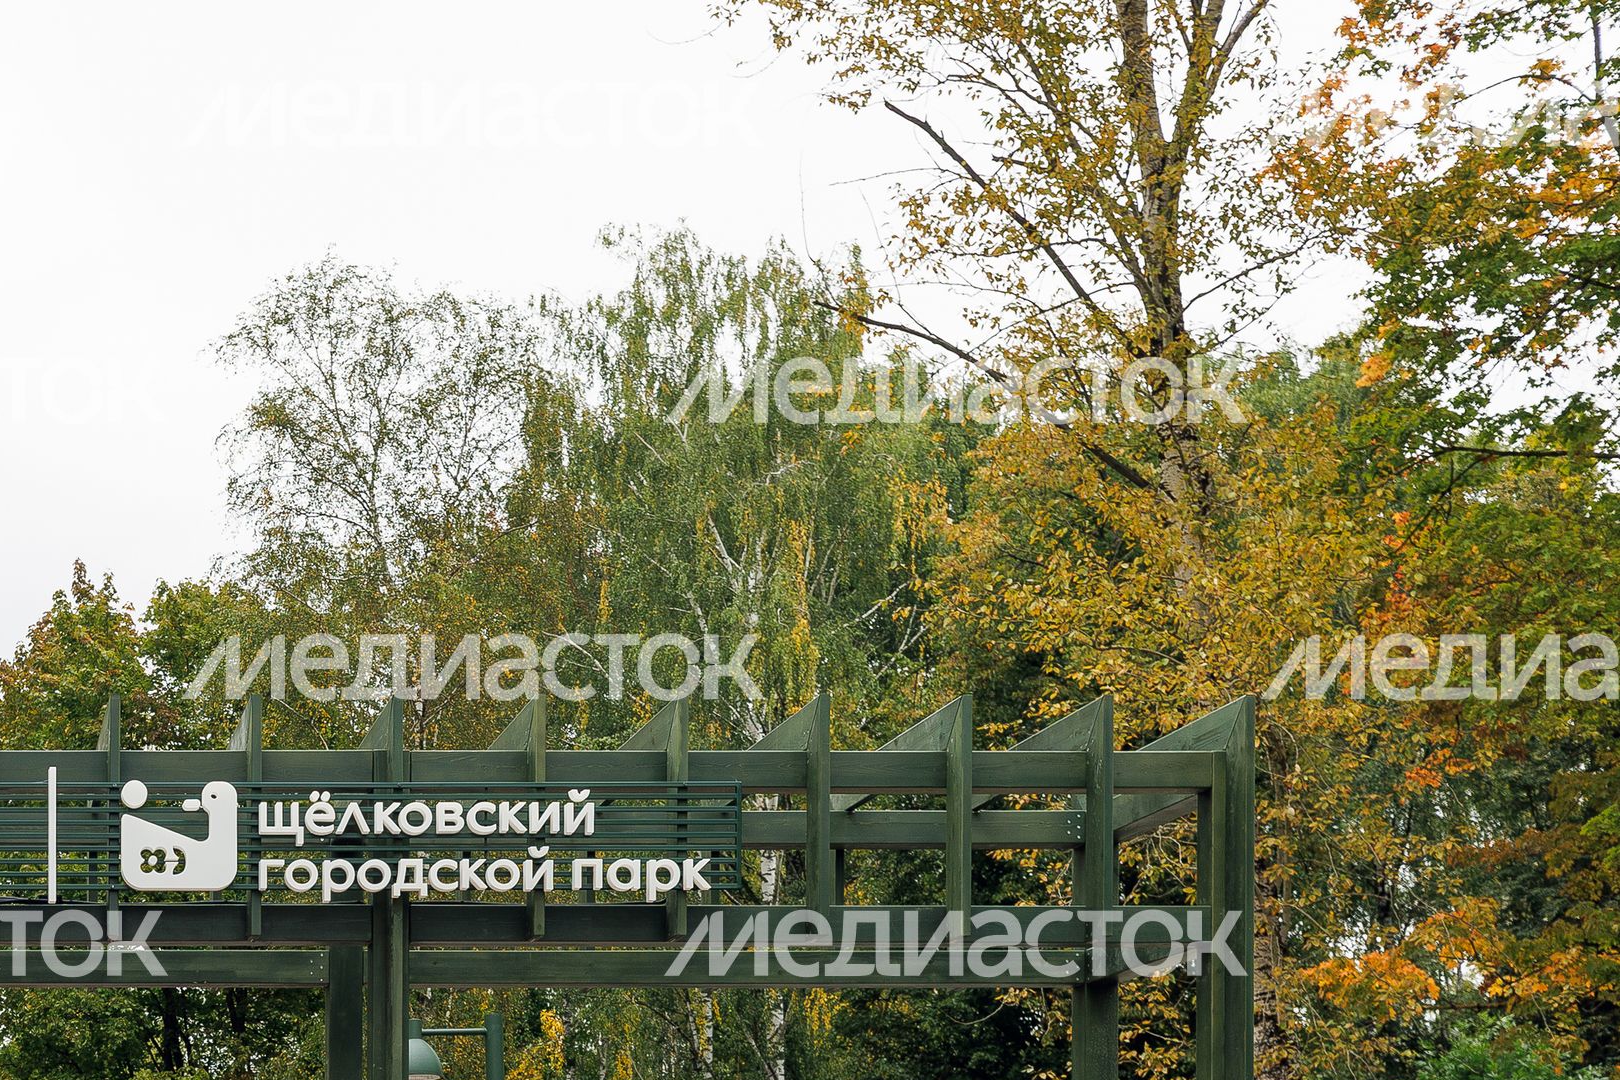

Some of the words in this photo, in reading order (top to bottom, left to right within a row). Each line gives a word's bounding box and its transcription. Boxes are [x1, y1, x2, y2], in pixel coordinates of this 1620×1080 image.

[258, 789, 596, 846] щёлковский
[258, 846, 554, 901] городской
[571, 858, 713, 902] парк
